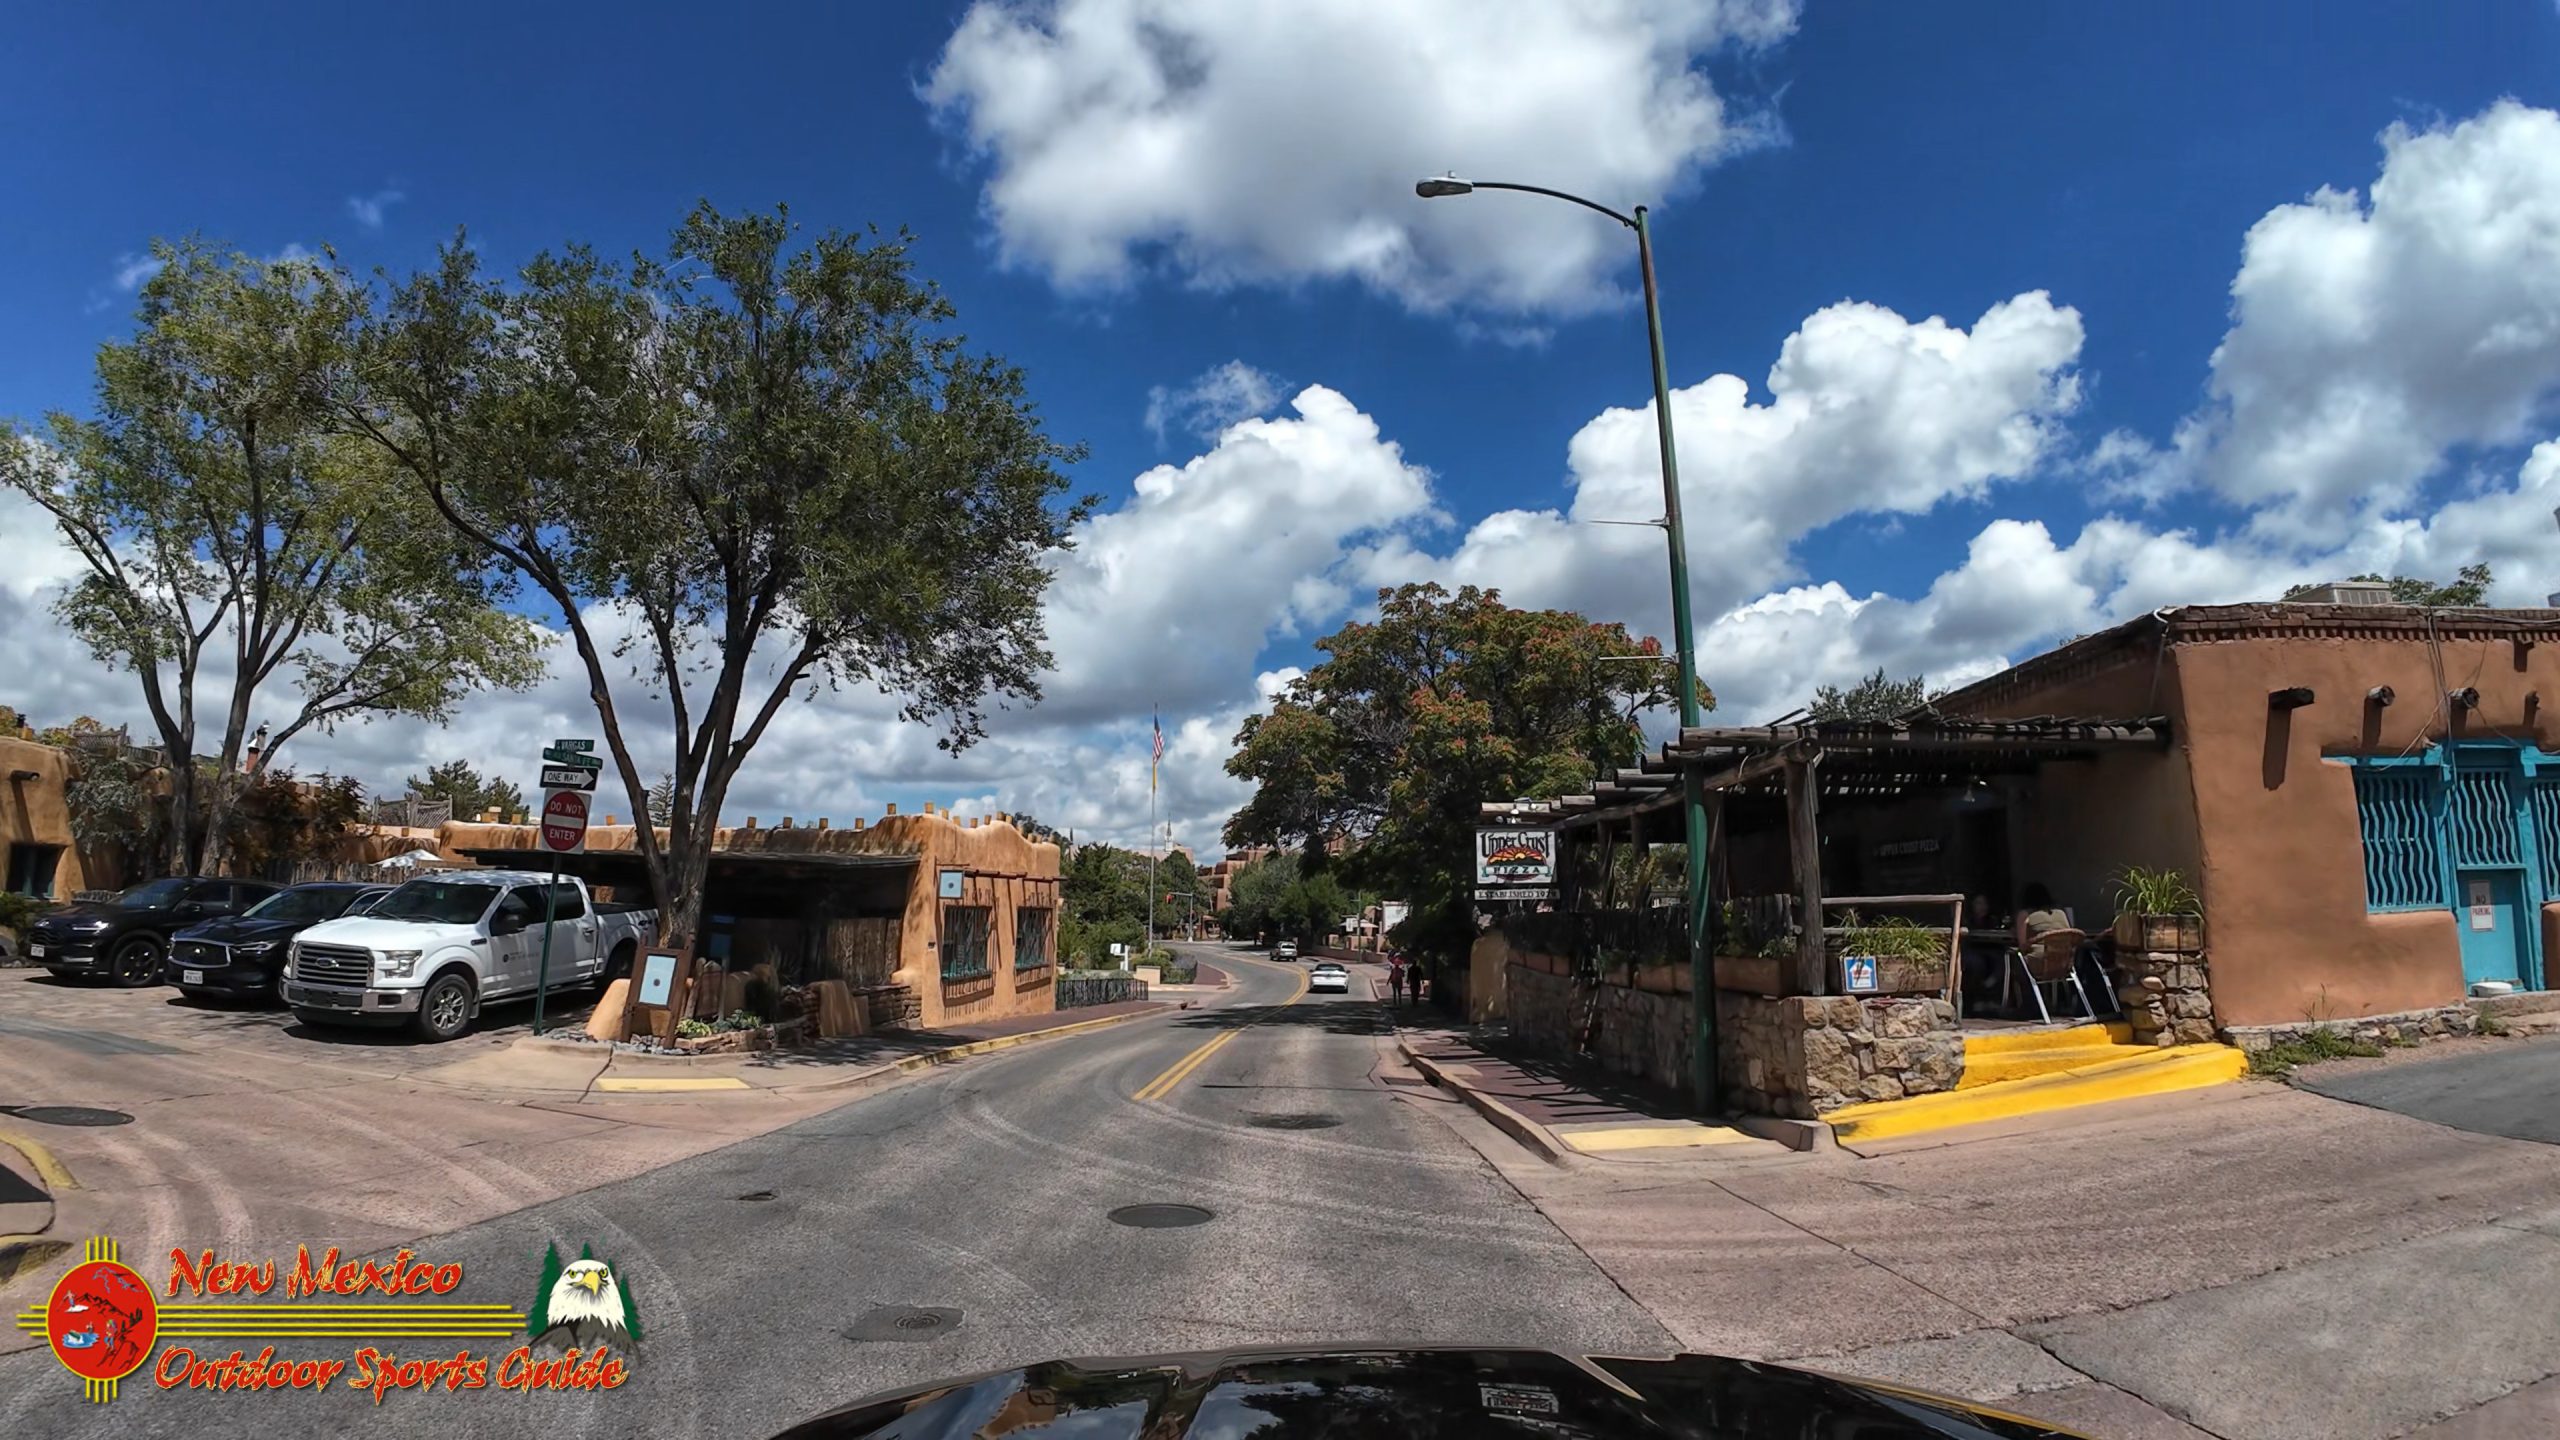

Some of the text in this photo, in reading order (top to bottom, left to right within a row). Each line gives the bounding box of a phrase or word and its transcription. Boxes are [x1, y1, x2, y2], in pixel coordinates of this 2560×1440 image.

[561, 740, 586, 751] VARGAS
[547, 772, 579, 783] ONE WAY
[550, 800, 583, 814] DO NOT
[549, 828, 576, 840] ENTER
[1480, 831, 1552, 858] Upper Crust
[1493, 866, 1541, 874] PIZZA
[1478, 889, 1535, 899] ESTABLISHED
[2475, 895, 2487, 905] NO
[2472, 907, 2491, 916] PARKING
